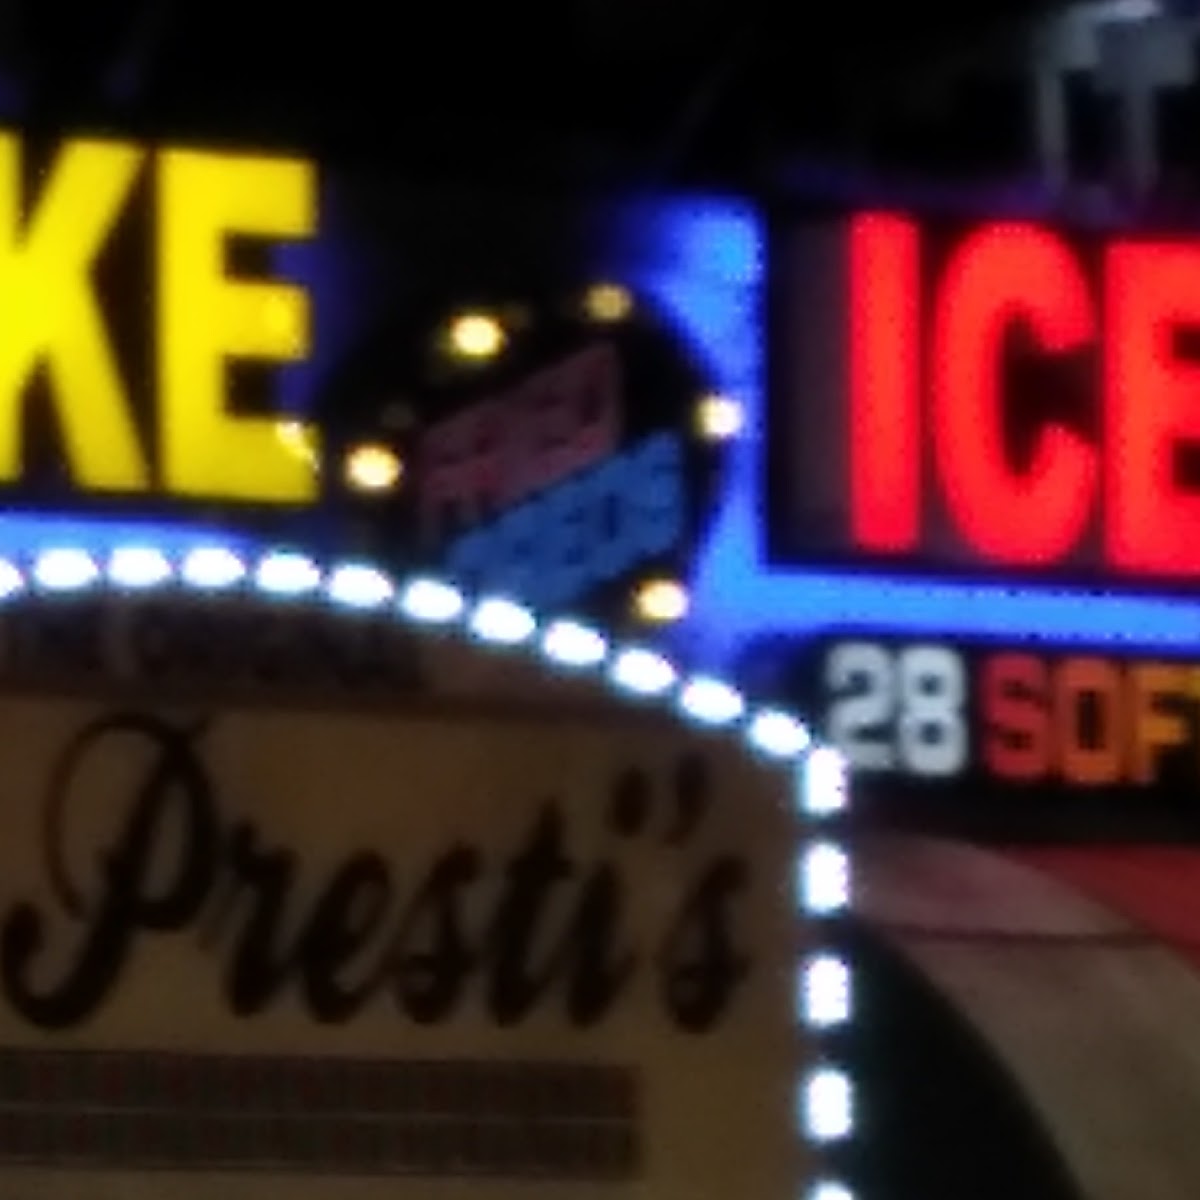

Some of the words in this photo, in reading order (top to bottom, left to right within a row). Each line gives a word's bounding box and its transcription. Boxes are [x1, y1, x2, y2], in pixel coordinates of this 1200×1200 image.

[848, 209, 1200, 576] ICE
[826, 640, 968, 776] 28
[980, 650, 1200, 784] SOF
